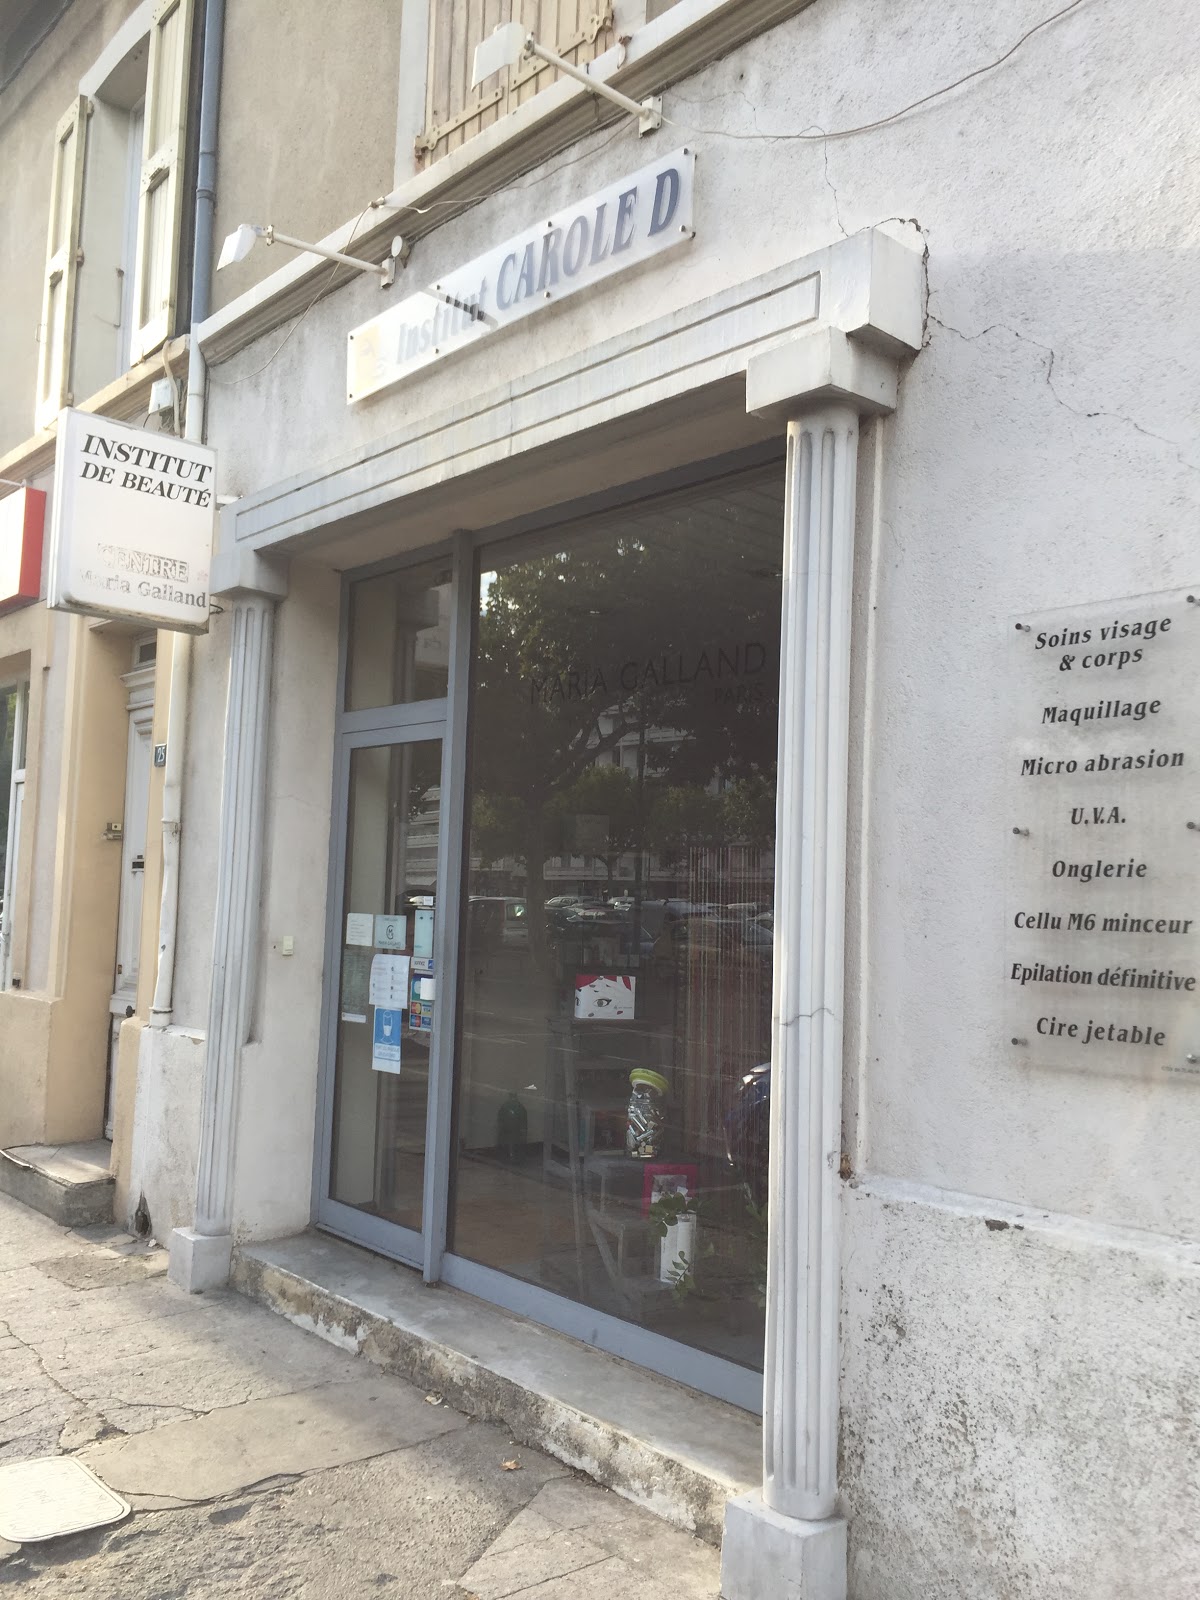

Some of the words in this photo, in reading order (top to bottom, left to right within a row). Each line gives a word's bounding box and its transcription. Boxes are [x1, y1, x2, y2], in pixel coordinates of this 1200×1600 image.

[397, 276, 488, 364] Institut
[496, 186, 638, 310] CAROLE
[647, 168, 681, 238] D
[80, 434, 212, 483] INSTITUT
[80, 461, 113, 484] DE
[120, 472, 211, 508] BEAUTÉ
[98, 544, 189, 583] CENTRE
[138, 581, 207, 608] Galland
[1035, 628, 1092, 650] Soins
[1101, 618, 1172, 640] visage
[1059, 654, 1075, 671] &
[1082, 648, 1143, 670] corps
[531, 667, 608, 705] MARIA
[621, 642, 767, 692] GALLAND
[1042, 700, 1161, 726] Maquillage
[157, 746, 165, 763] 25
[1021, 757, 1078, 776] Micro
[1084, 749, 1184, 772] abrasion
[1071, 806, 1126, 825] U.V.A.
[1052, 858, 1147, 883] Onglerie
[1014, 911, 1062, 930] Cellu
[1067, 913, 1096, 931] M6
[1101, 913, 1193, 934] minceur
[1010, 963, 1092, 985] Epilation
[1097, 967, 1196, 991] définitive
[1036, 1016, 1078, 1038] Cire
[1082, 1020, 1166, 1046] jetable
